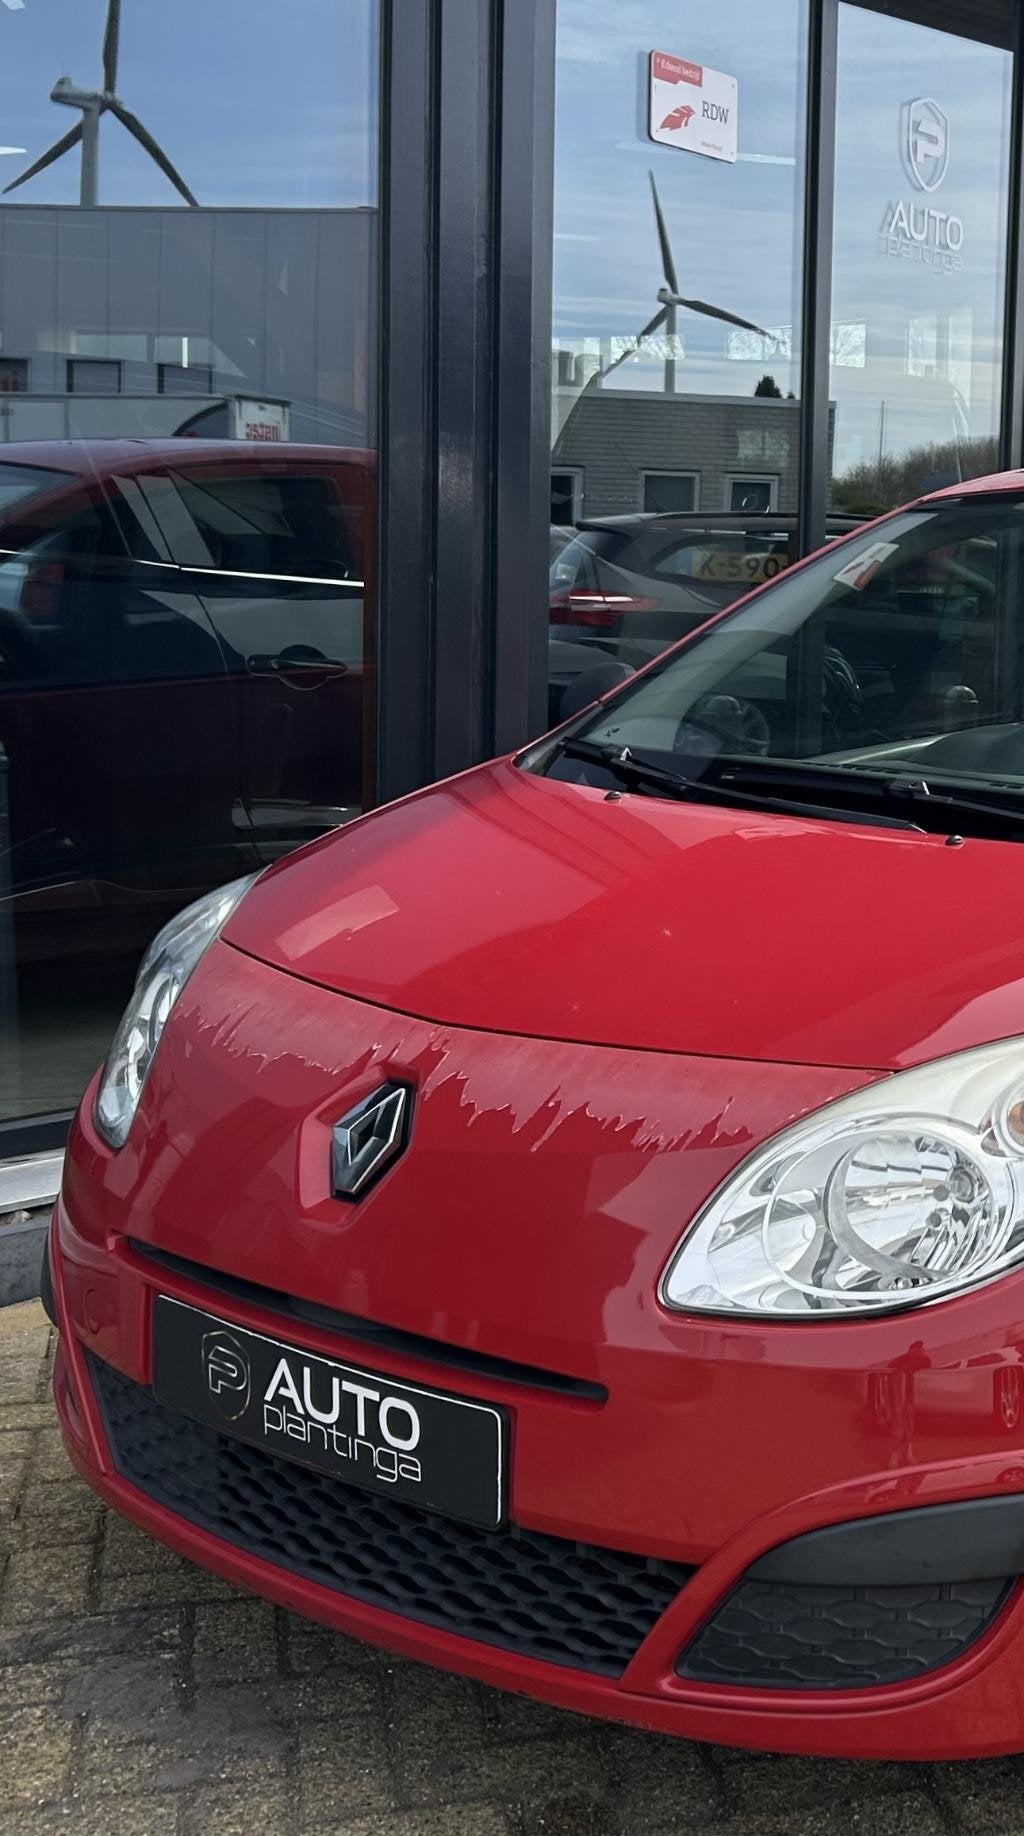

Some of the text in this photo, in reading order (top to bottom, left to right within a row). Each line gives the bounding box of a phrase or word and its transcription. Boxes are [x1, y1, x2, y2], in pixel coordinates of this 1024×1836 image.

[702, 101, 729, 124] RDW
[889, 200, 963, 251] AUTO
[263, 1358, 421, 1451] AUTO
[263, 1404, 422, 1483] plantinga
